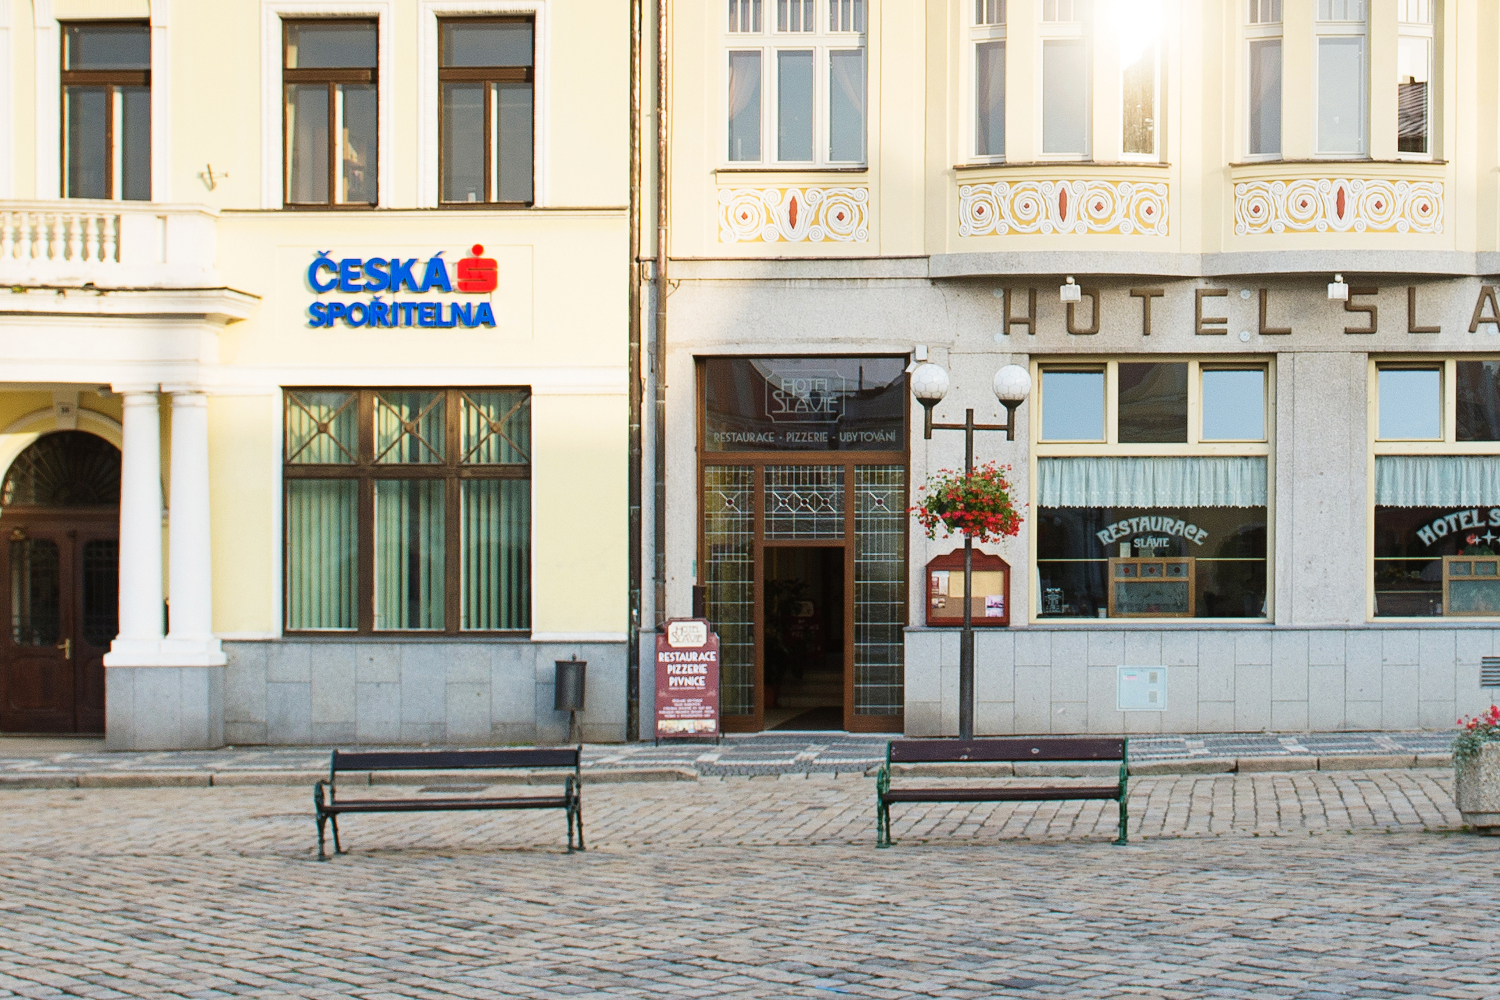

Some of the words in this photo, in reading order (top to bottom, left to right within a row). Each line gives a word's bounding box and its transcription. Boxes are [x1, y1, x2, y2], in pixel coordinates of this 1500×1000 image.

[308, 250, 452, 292] ČESKÁ
[308, 296, 497, 327] SPOŘITELNA
[1003, 288, 1292, 335] HOTEL
[781, 377, 828, 398] HOTEL
[714, 432, 775, 443] RESTAURACE
[786, 432, 828, 443] PIZZERIE
[839, 430, 896, 443] UBYTOVÁNÍ
[1095, 516, 1209, 546] RESTAURACE
[1416, 509, 1486, 547] HOTEL
[1133, 535, 1170, 548] SLÁVIE
[658, 651, 717, 662] RESTAURACE
[667, 664, 708, 675] PIZZERIE
[668, 676, 706, 687] PIVNICE
